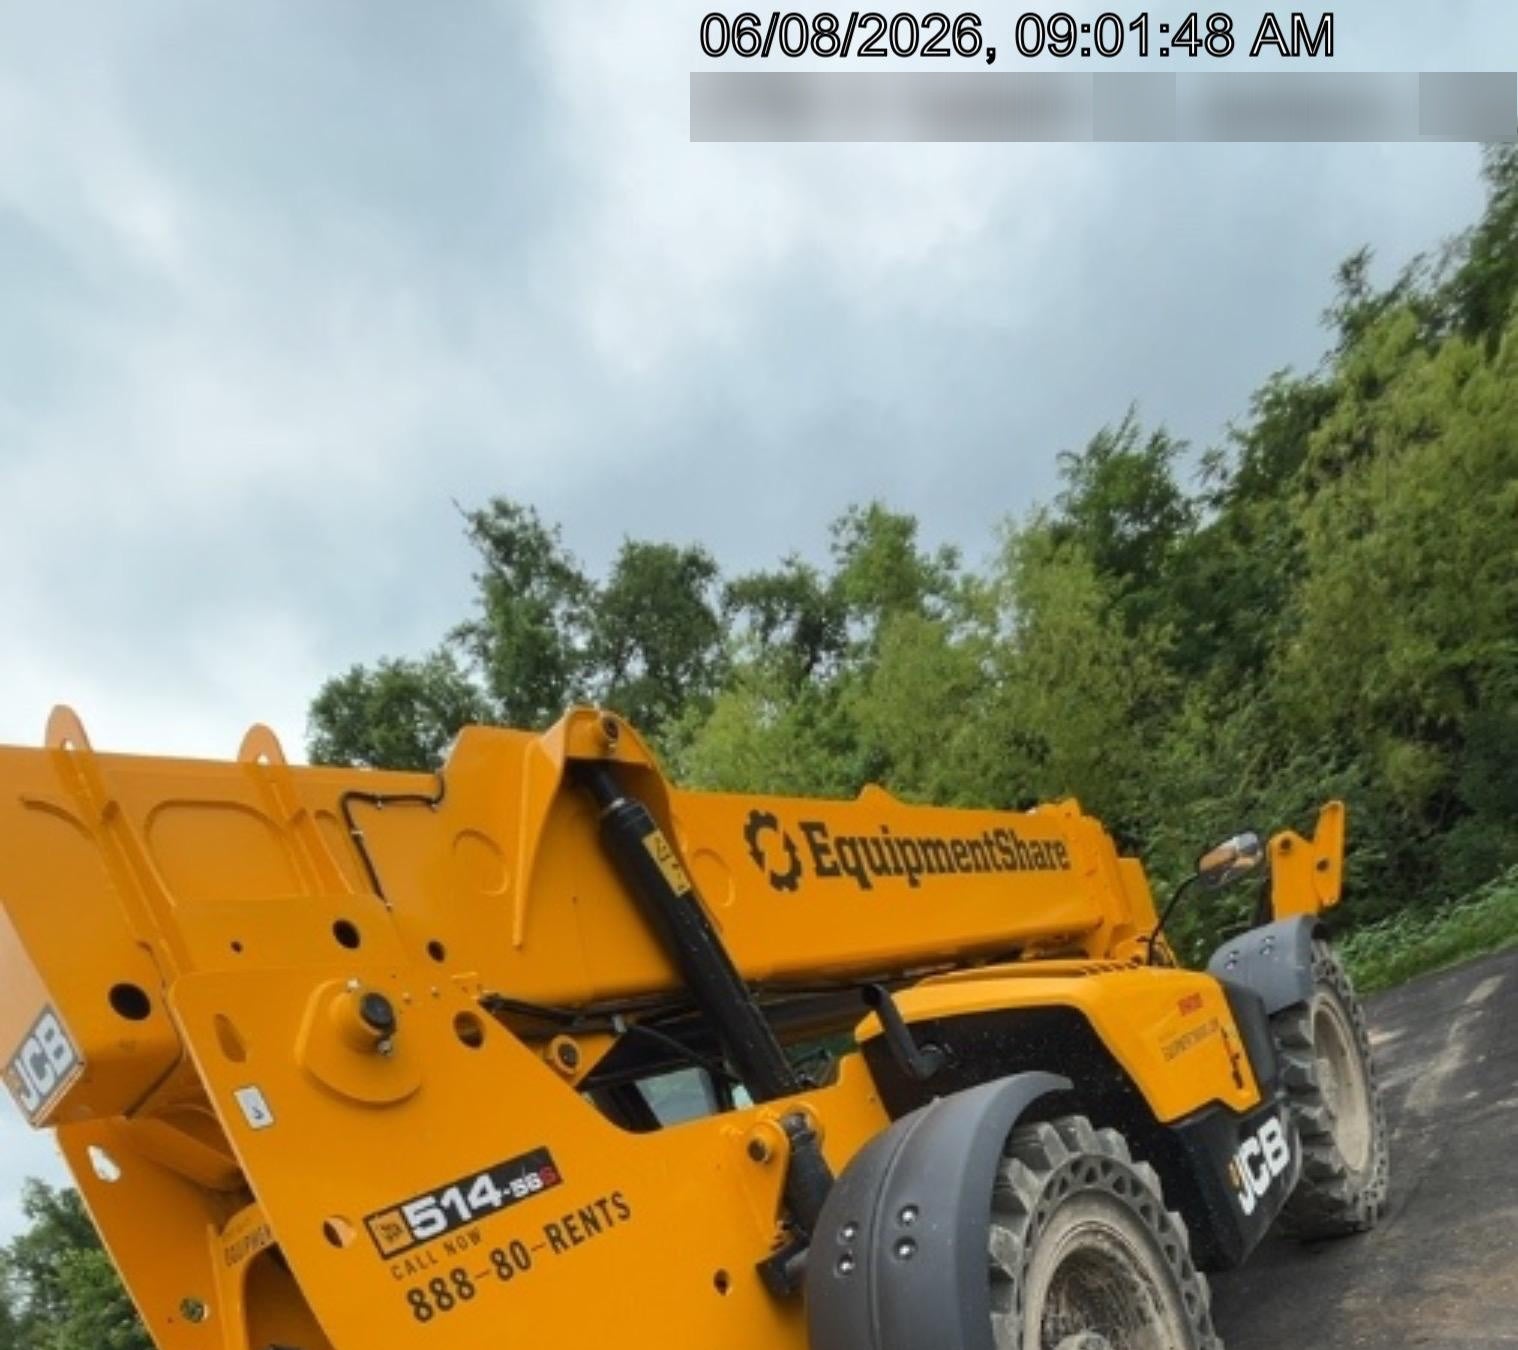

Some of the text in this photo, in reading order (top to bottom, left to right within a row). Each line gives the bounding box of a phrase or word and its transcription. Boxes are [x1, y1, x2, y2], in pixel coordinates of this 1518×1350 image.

[799, 821, 1071, 890] EquipmentShare
[14, 1012, 74, 1112] JCB
[1231, 1115, 1290, 1216] JCB
[390, 1229, 483, 1281] CALL NOW
[406, 1190, 632, 1323] 888-80-RENTS
